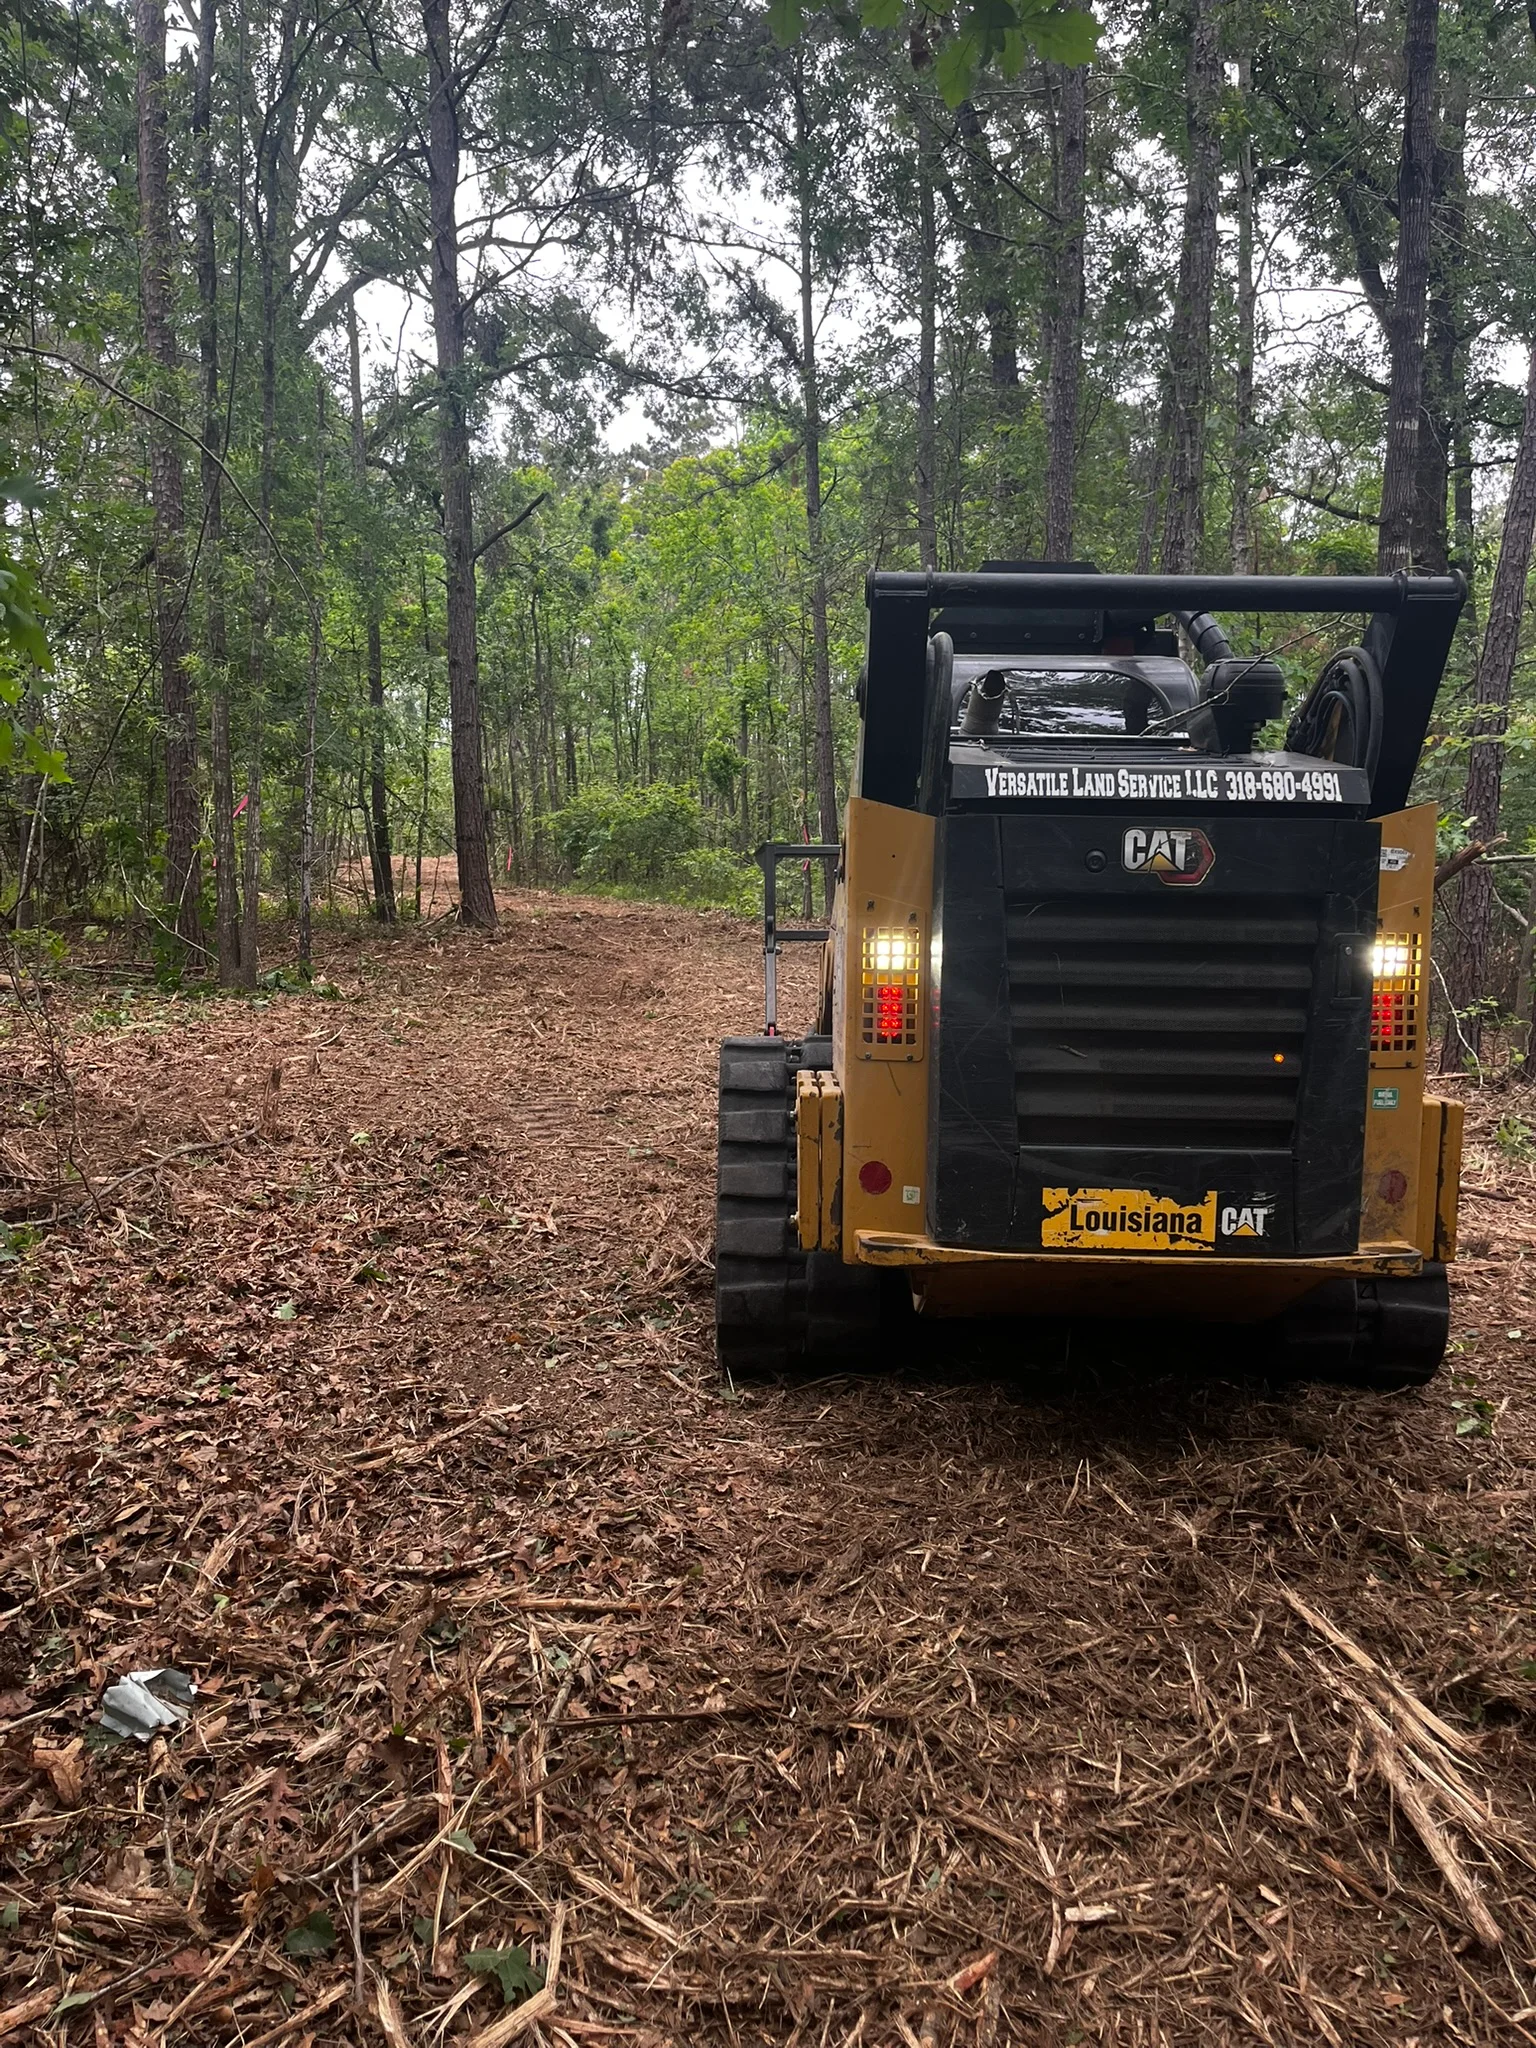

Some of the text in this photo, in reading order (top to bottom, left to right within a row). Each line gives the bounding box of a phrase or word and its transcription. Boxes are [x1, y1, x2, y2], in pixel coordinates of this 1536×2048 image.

[985, 767, 1343, 802] VERSATILE LAND SERVICE LLC 318-680-4991
[1124, 829, 1192, 871] CAT
[1070, 1204, 1268, 1236] Louisiana CAT
